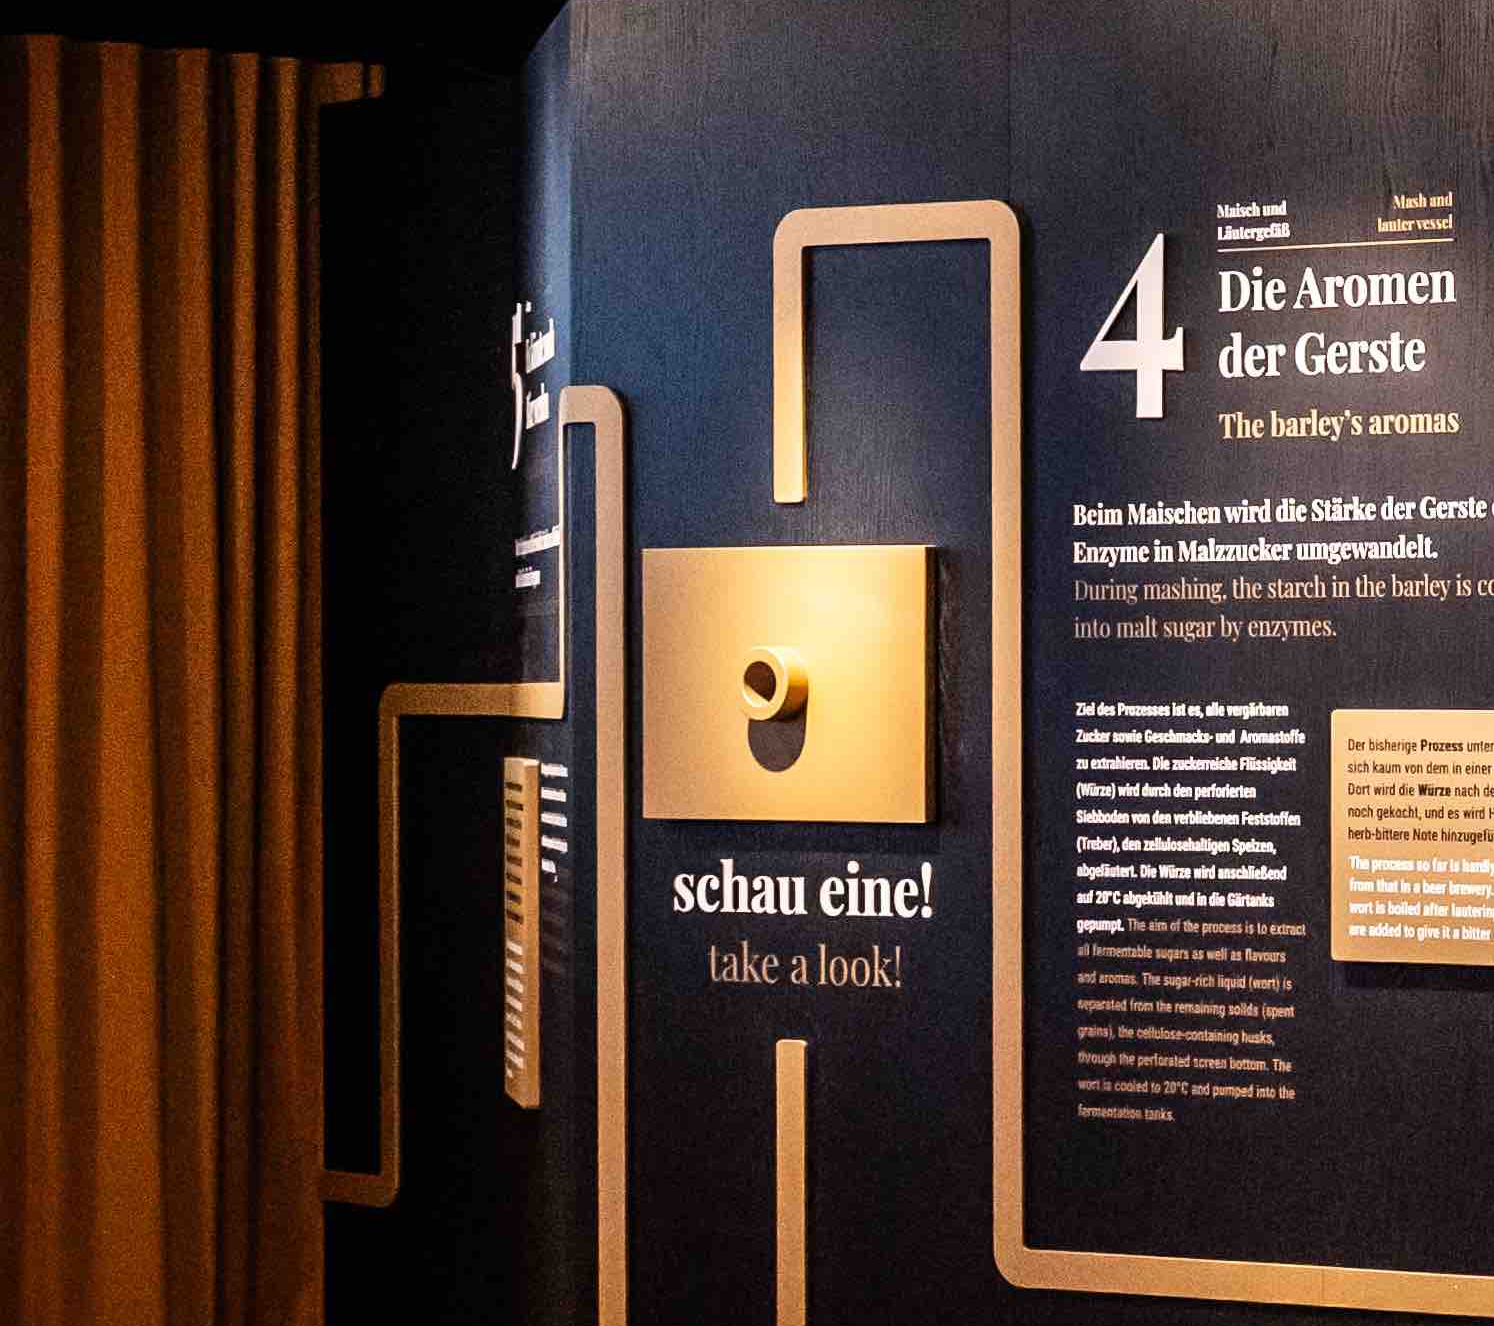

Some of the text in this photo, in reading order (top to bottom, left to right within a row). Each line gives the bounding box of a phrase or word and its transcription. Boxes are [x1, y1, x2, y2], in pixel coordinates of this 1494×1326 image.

[1217, 200, 1287, 219] Maisch und
[1394, 191, 1452, 210] Mash and
[1219, 266, 1456, 312] Die Aromen
[1080, 233, 1184, 418] 4
[1219, 331, 1425, 378] der Gerste
[1073, 502, 1123, 526] Beim
[1128, 500, 1221, 526] Maischen
[1224, 498, 1271, 524] wird
[1276, 497, 1307, 523] die
[1312, 495, 1376, 522] Stärke
[1381, 495, 1416, 521] der
[1420, 496, 1487, 520] Gerste
[1074, 534, 1438, 568] Enzyme in Malzzucker umgewandelt.
[1076, 578, 1138, 604] During
[1233, 576, 1262, 599] the
[1268, 574, 1326, 599] starch
[1332, 575, 1350, 598] in
[1356, 574, 1385, 598] the
[1392, 573, 1450, 601] barley
[1456, 574, 1471, 596] is
[1076, 614, 1336, 643] into malt sugar by enzymes.
[1348, 738, 1365, 752] Der
[1369, 738, 1417, 756] bisherige
[1421, 738, 1463, 752] Prozess
[1348, 827, 1409, 841] herb-bittere
[1413, 828, 1438, 842] Note
[674, 859, 932, 918] schau eine!
[708, 941, 900, 988] take a look!
